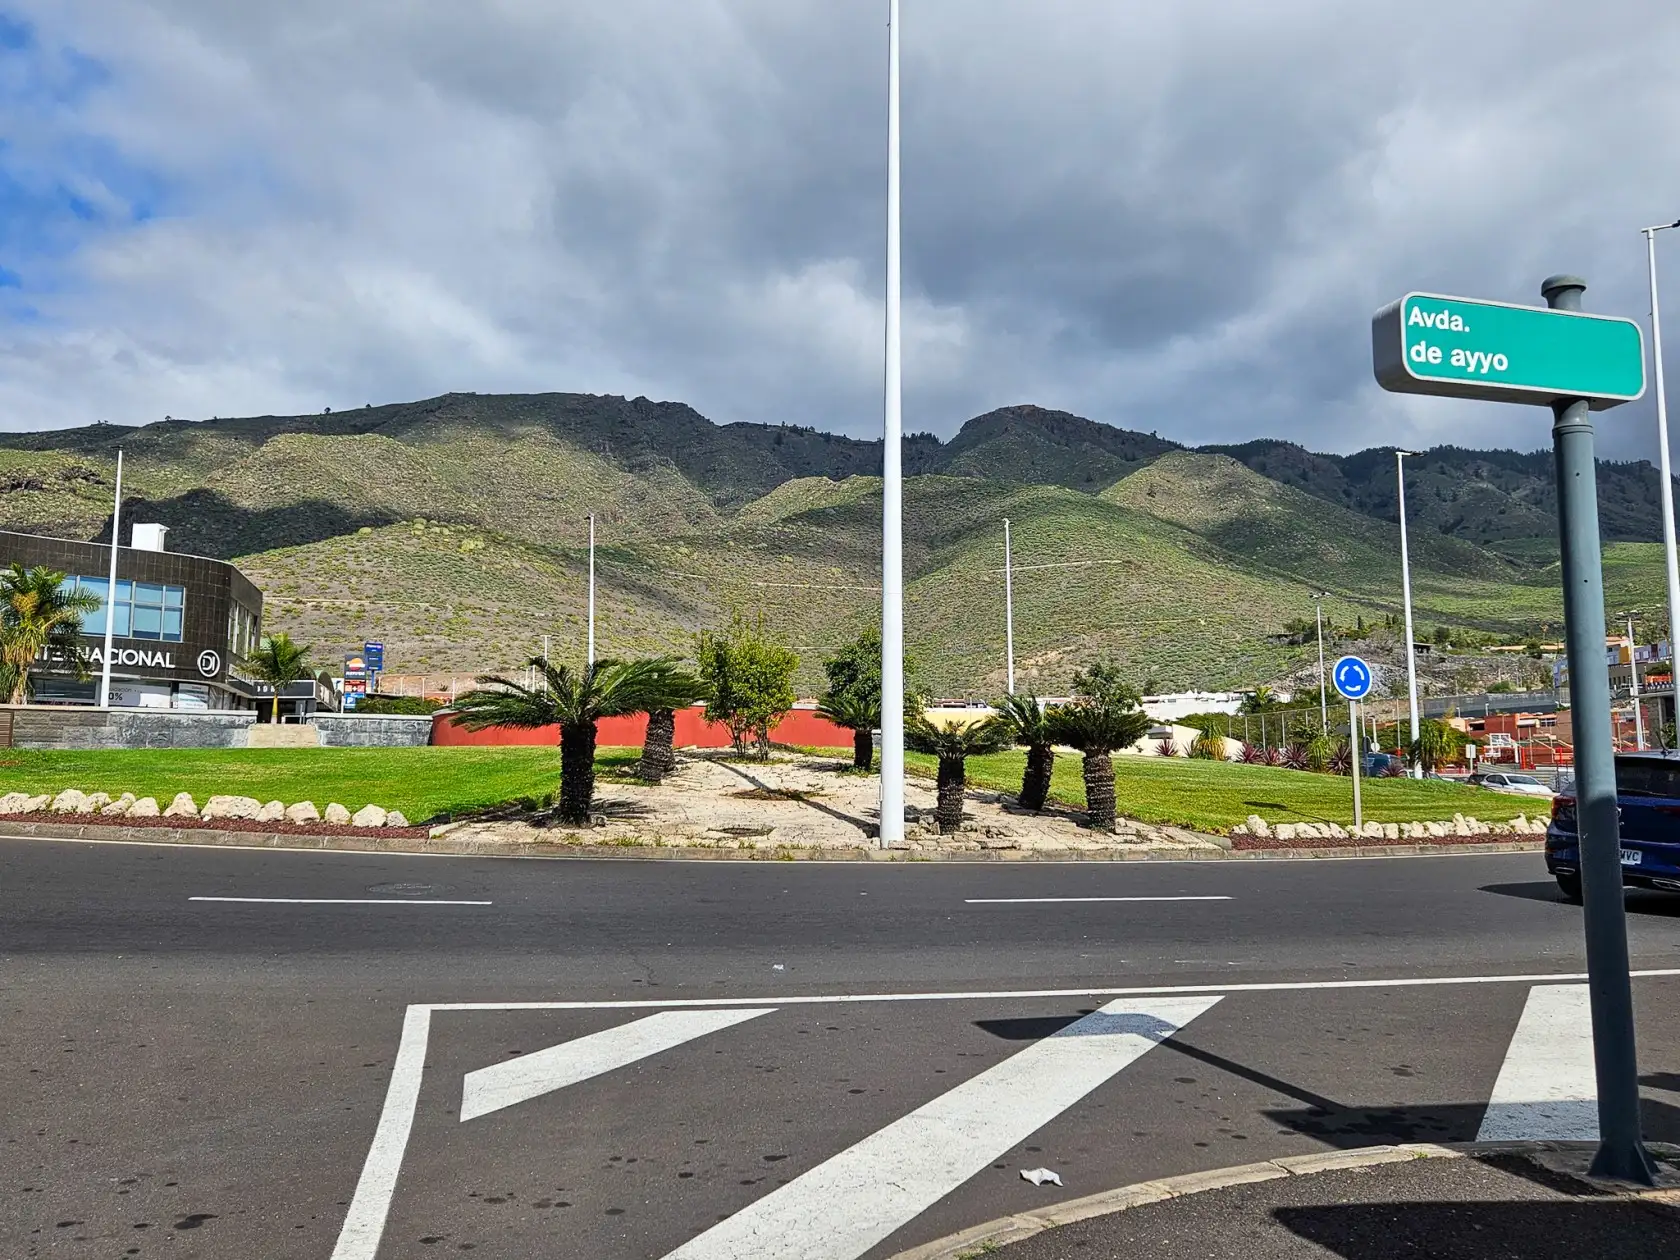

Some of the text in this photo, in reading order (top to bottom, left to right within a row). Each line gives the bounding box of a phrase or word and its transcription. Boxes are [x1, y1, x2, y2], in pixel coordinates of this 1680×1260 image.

[1408, 306, 1470, 332] Avda.
[1410, 340, 1508, 374] de ayyo
